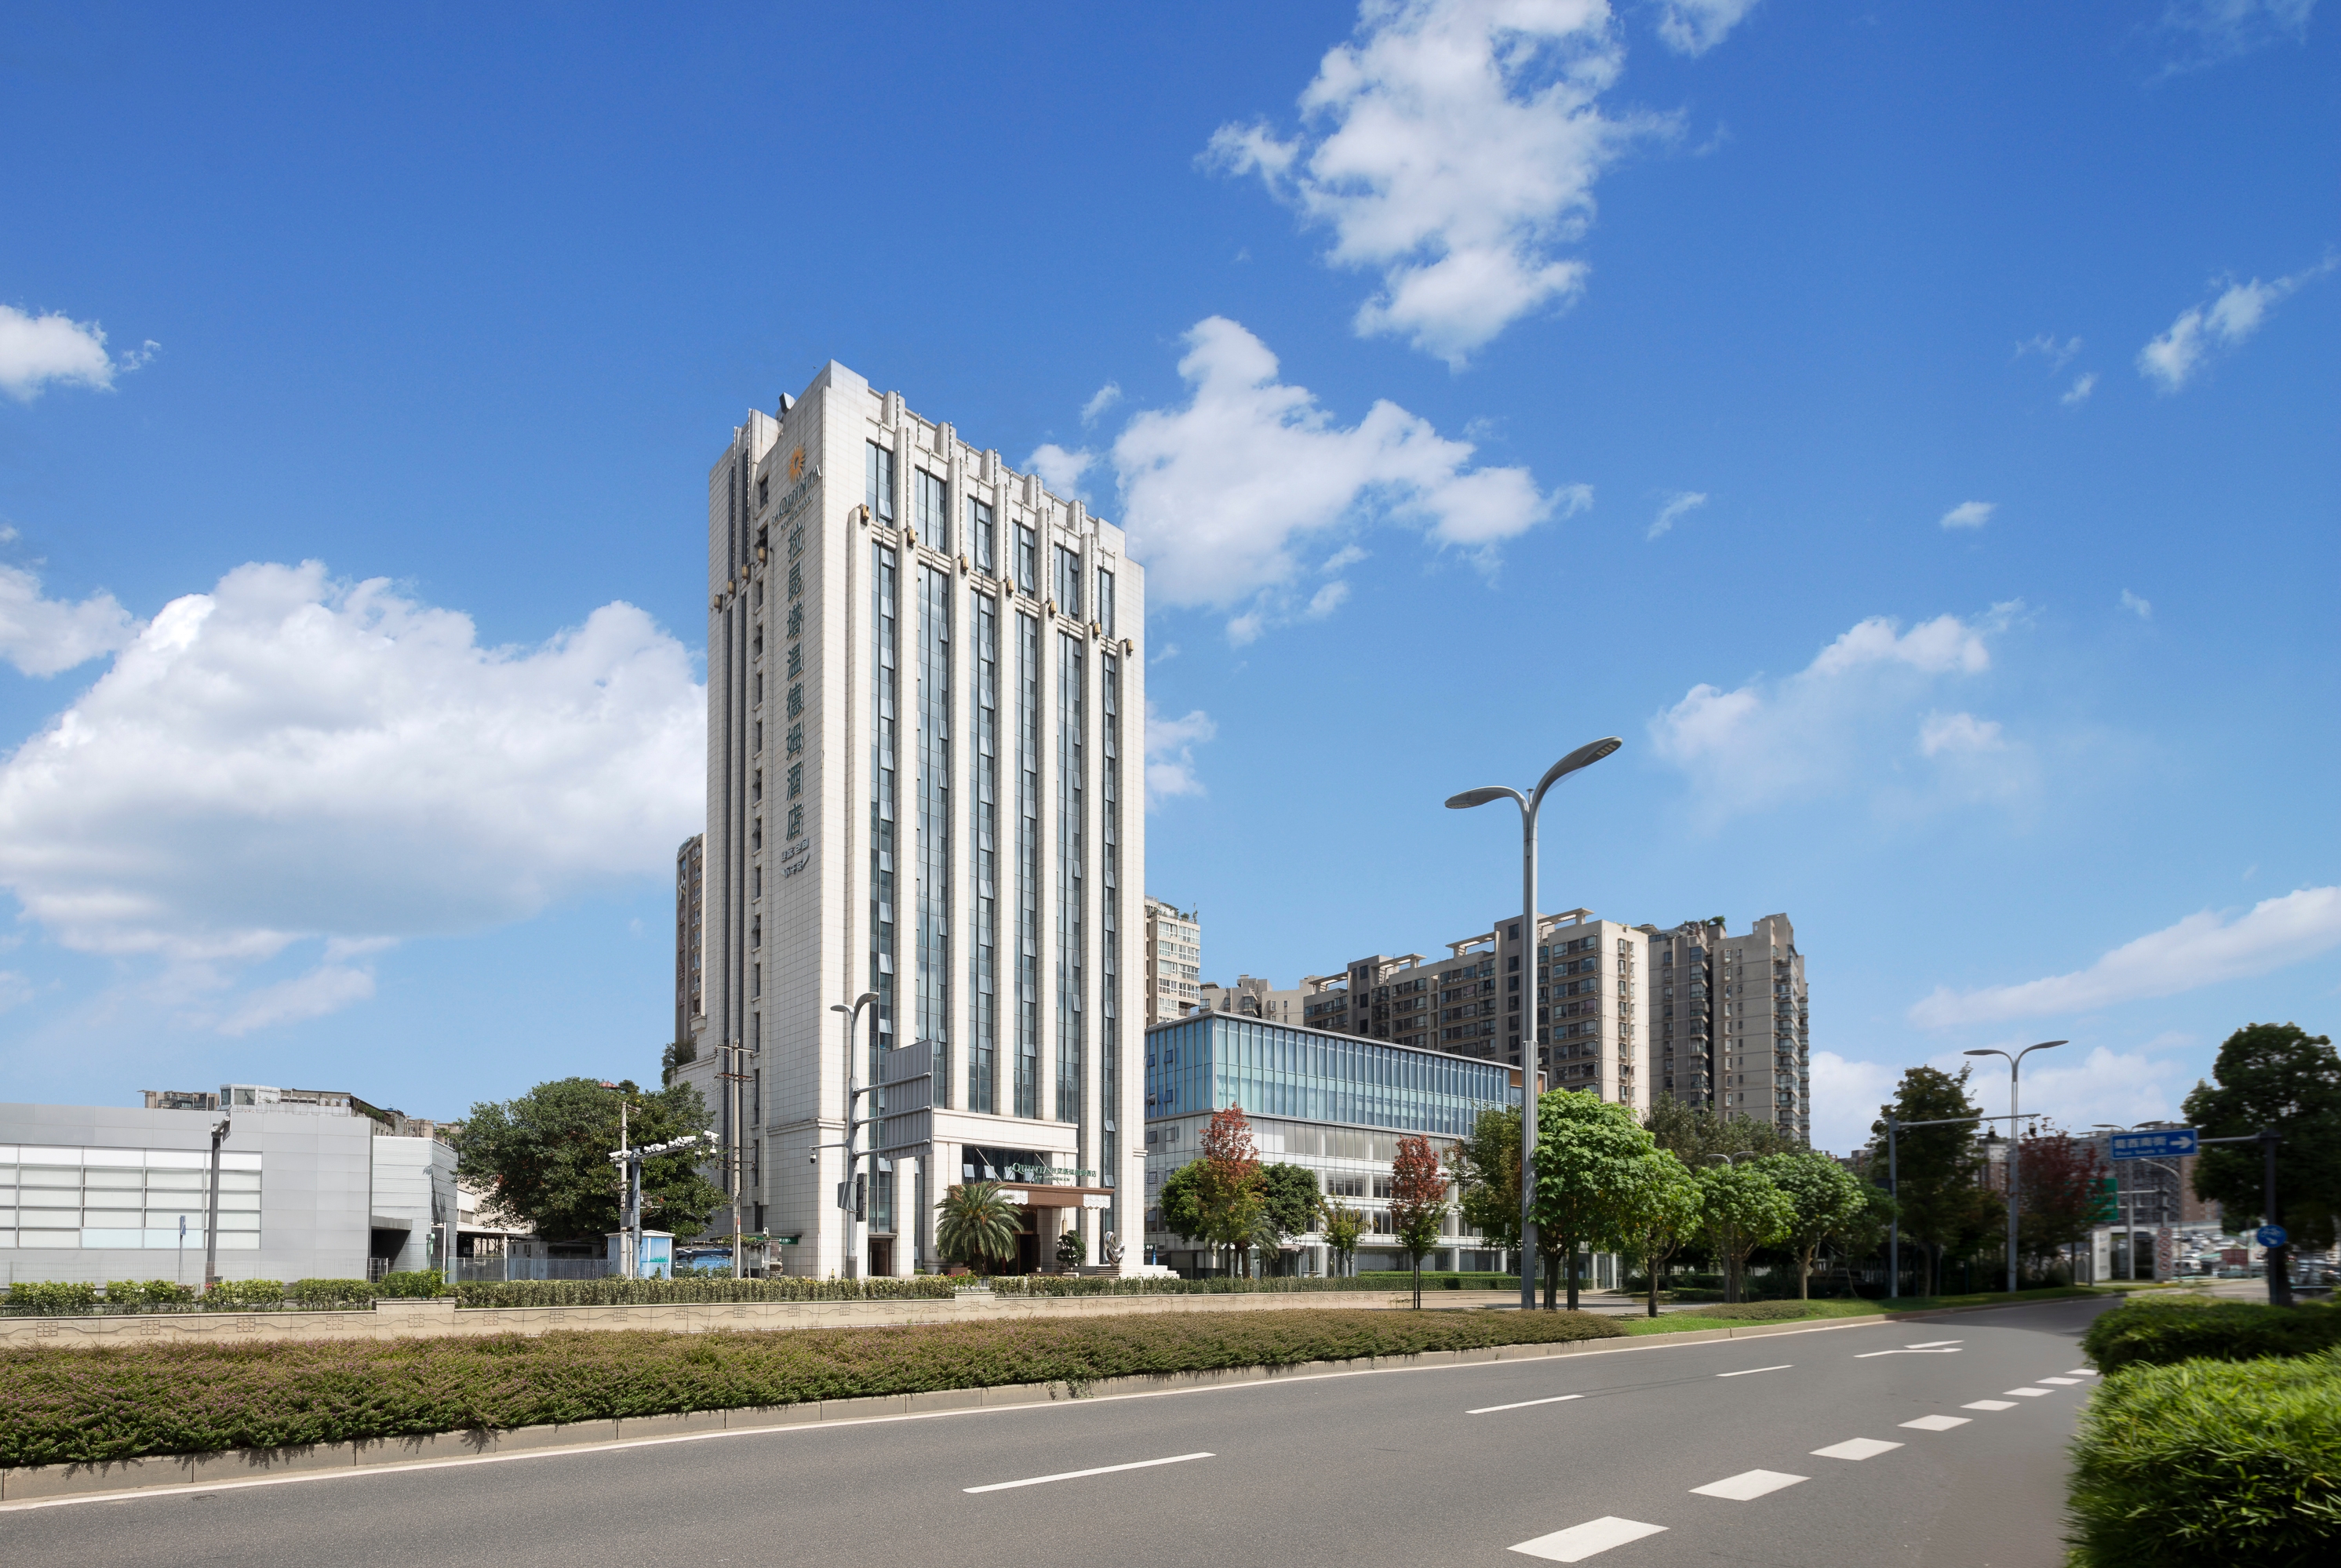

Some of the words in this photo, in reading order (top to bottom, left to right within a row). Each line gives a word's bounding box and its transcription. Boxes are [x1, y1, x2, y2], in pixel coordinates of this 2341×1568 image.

[779, 464, 822, 515] QUINTA
[788, 493, 813, 523] WYNDHAM
[786, 522, 805, 842] 拉昆塔温德姆酒店
[1013, 1162, 1051, 1175] QUINTA
